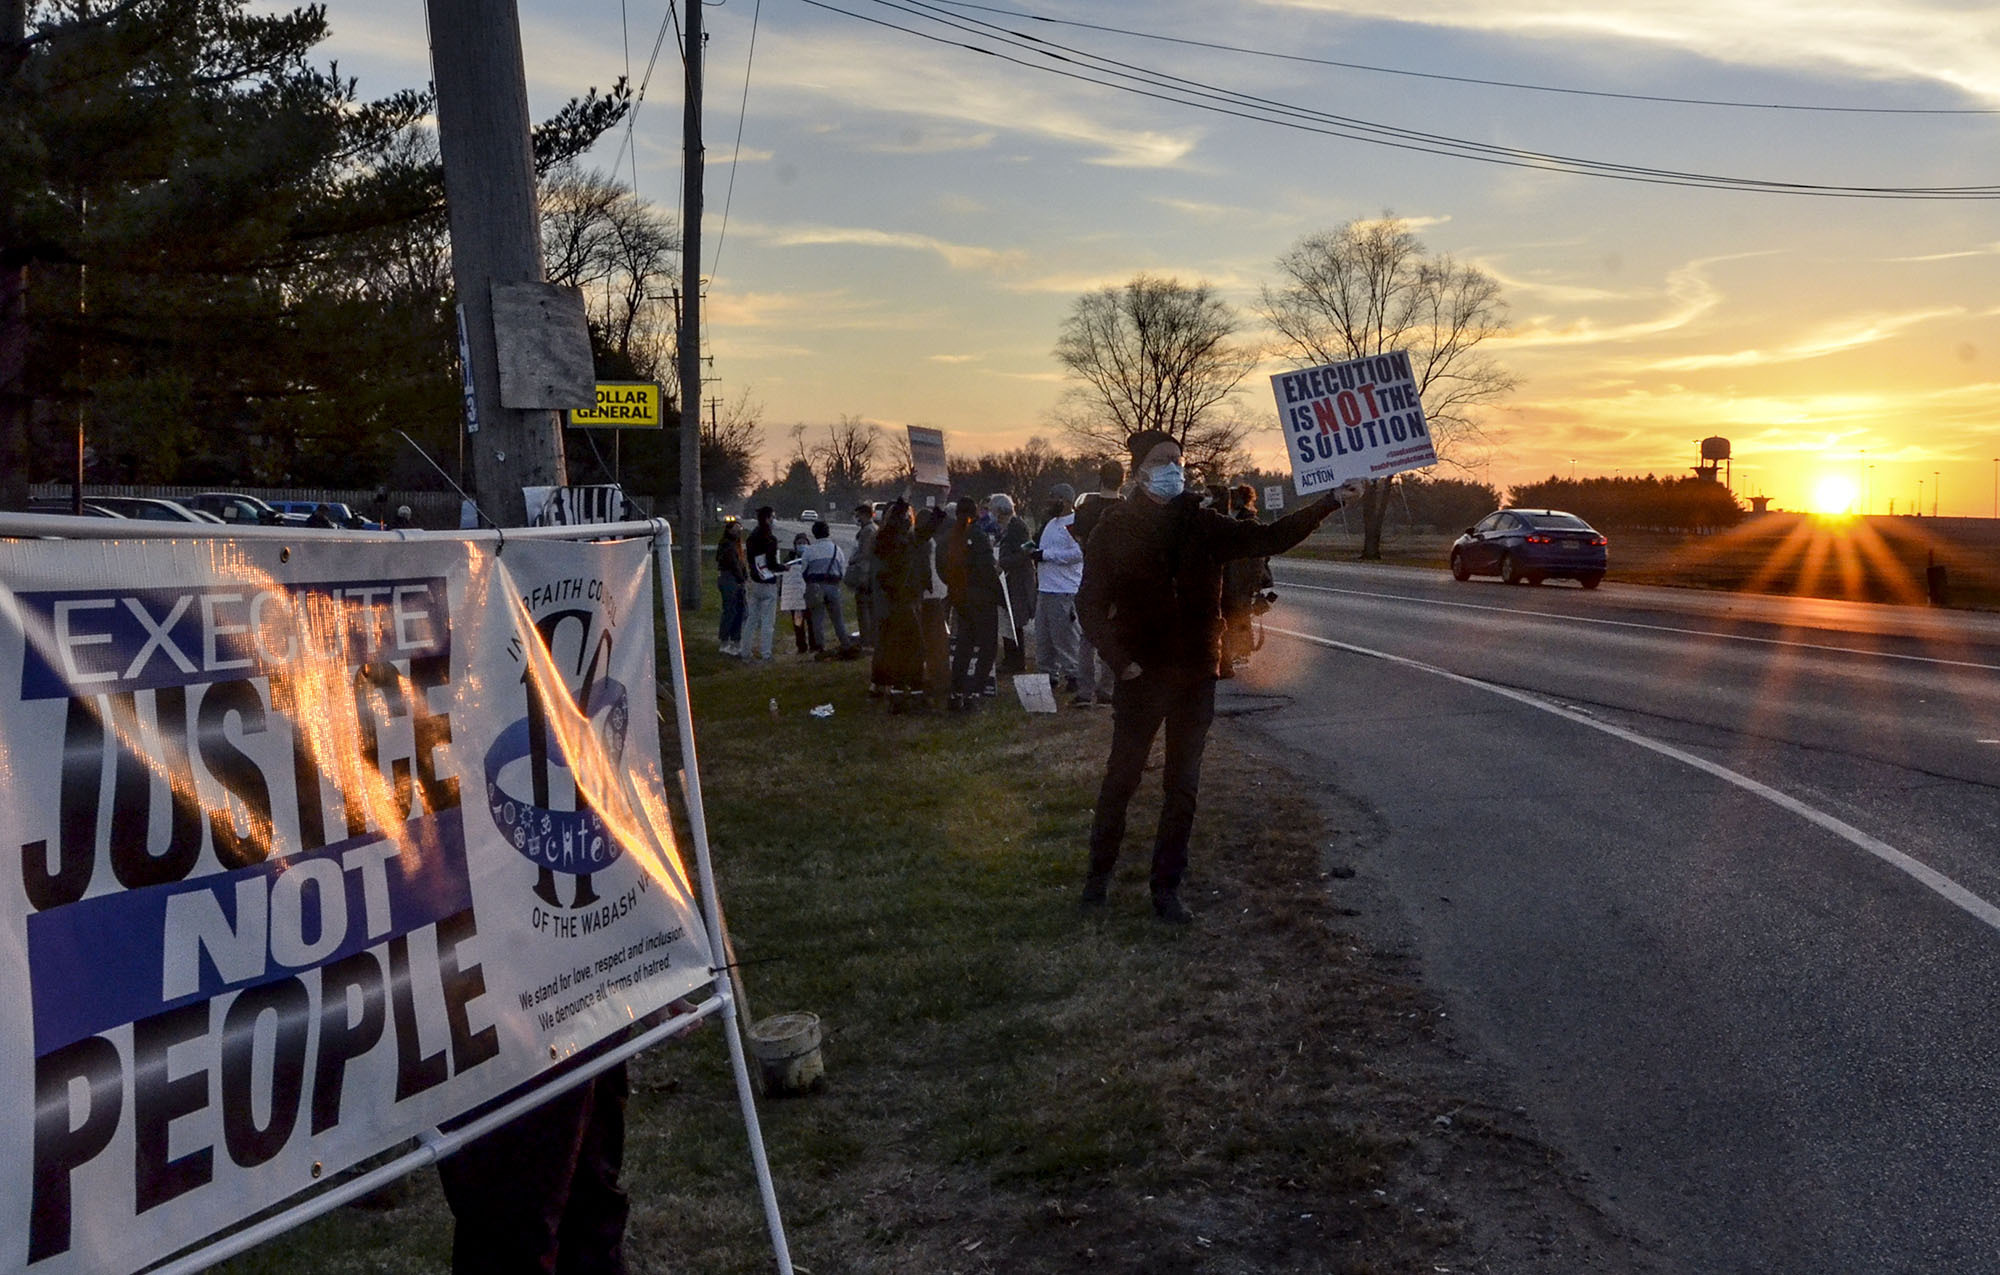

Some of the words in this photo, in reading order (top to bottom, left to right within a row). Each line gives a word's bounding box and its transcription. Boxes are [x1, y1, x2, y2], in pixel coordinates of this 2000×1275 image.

[595, 390, 648, 404] OLLAR
[1282, 353, 1409, 404] EXECUTION
[577, 405, 652, 419] GENERAL
[1289, 405, 1315, 432] IS
[1311, 383, 1380, 436] NOT
[1375, 383, 1419, 414] THE
[1297, 410, 1426, 463] SOLUTION
[1301, 468, 1336, 488] ACTION
[54, 584, 434, 684] EXECUTE
[21, 654, 460, 913] JUSTICE
[162, 839, 401, 1002] NOT
[532, 907, 549, 933] OF
[553, 916, 577, 938] THE
[581, 887, 637, 935] WABASH
[518, 989, 534, 1011] We
[535, 978, 558, 1004] stand
[559, 973, 572, 989] for
[594, 949, 626, 975] respect
[628, 942, 643, 960] and
[538, 1010, 554, 1032] We
[555, 992, 595, 1025] denounce
[595, 982, 607, 1003] all
[607, 973, 632, 997] forms
[633, 967, 642, 983] of
[27, 907, 500, 1266] PEOPLE
